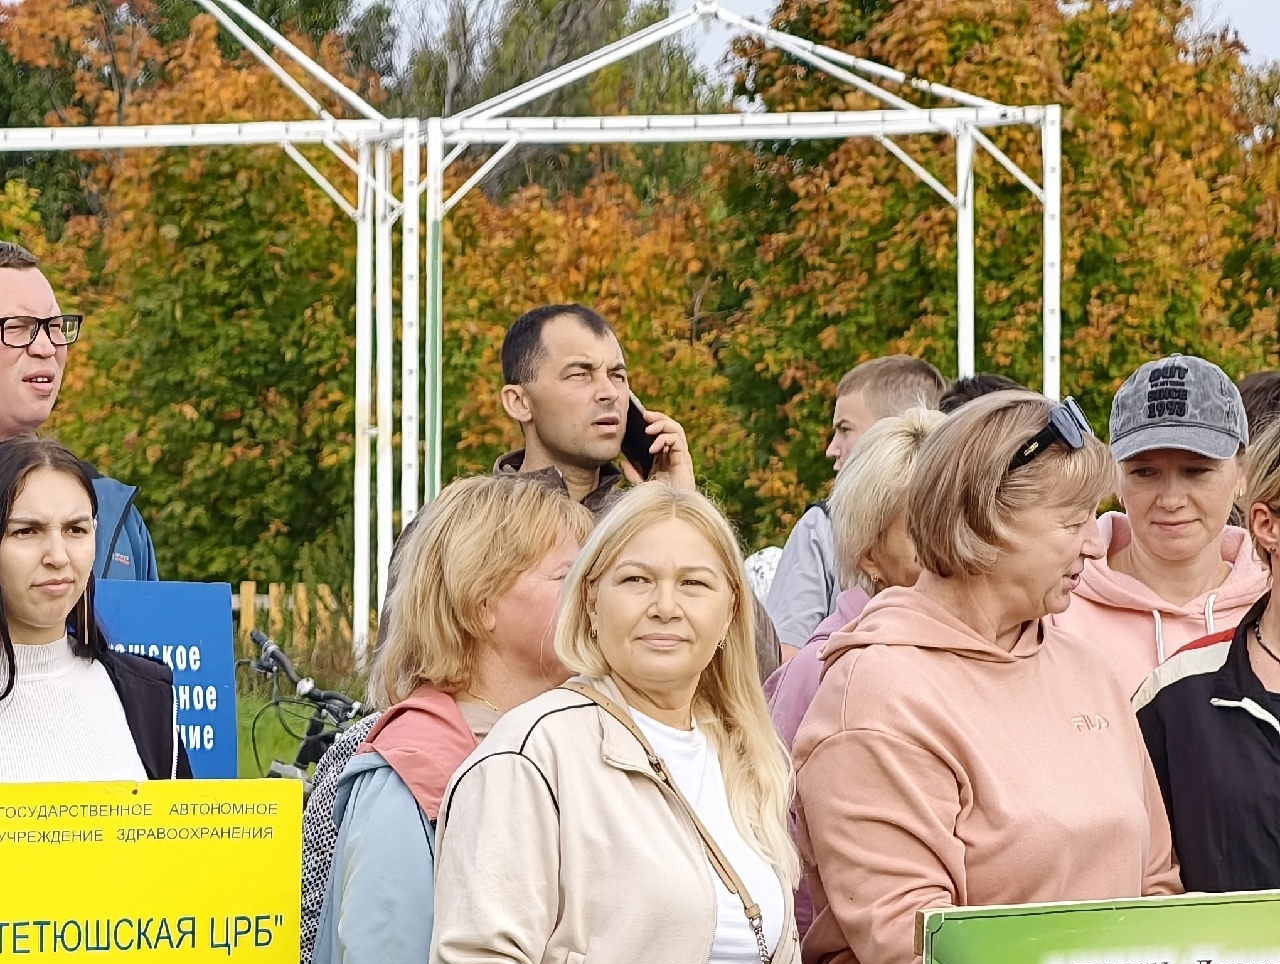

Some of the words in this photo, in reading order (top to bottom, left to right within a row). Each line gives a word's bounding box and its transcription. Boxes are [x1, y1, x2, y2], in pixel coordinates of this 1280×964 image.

[1071, 713, 1109, 733] FILA
[168, 802, 278, 816] АВТОНОМНОЕ
[116, 826, 274, 843] ЗДРАВООХРАНЕНИЯ
[209, 914, 284, 956] ЦРБ"
